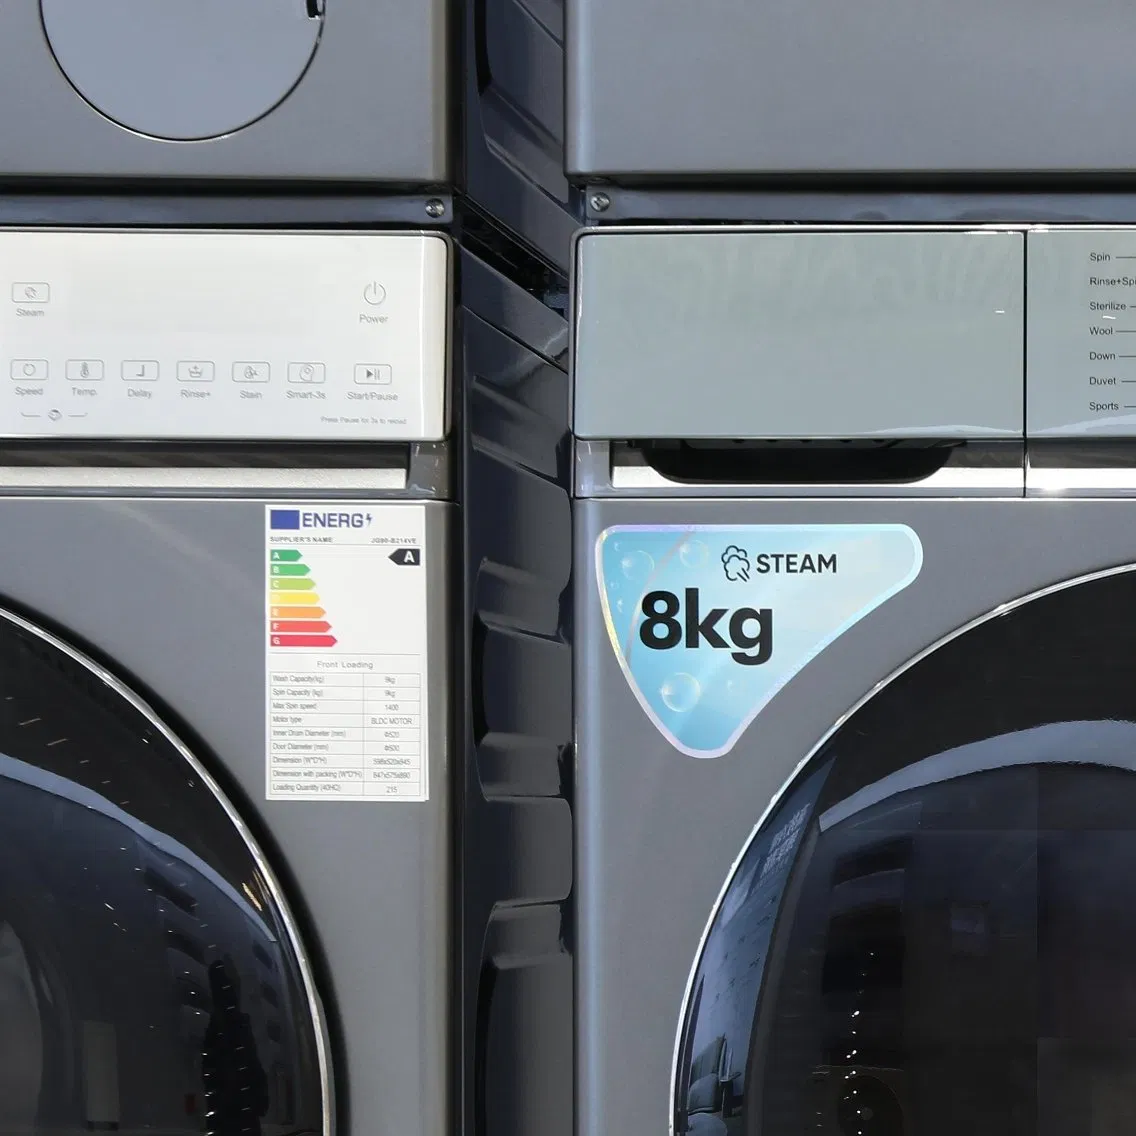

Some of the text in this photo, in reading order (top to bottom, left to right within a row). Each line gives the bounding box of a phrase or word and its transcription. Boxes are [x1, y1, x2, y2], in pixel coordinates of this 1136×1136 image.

[1090, 253, 1111, 262] Spin
[1089, 302, 1126, 311] Sterilize
[16, 308, 45, 318] Steam
[359, 314, 389, 324] Power
[1089, 327, 1113, 335] Wool
[1089, 352, 1116, 360] Down
[1089, 377, 1116, 385] Duvet
[15, 386, 44, 397] Speed
[72, 387, 98, 398] Temp.
[127, 388, 152, 399] Delay
[180, 389, 211, 399] Rinse+
[239, 389, 262, 400] Stain
[286, 389, 326, 400] Smart-3s
[347, 391, 398, 402] Start/Pause
[1089, 402, 1119, 412] Sports
[302, 513, 363, 528] ENERG
[404, 551, 415, 563] A
[756, 553, 837, 574] STEAM
[639, 588, 773, 666] 8kg
